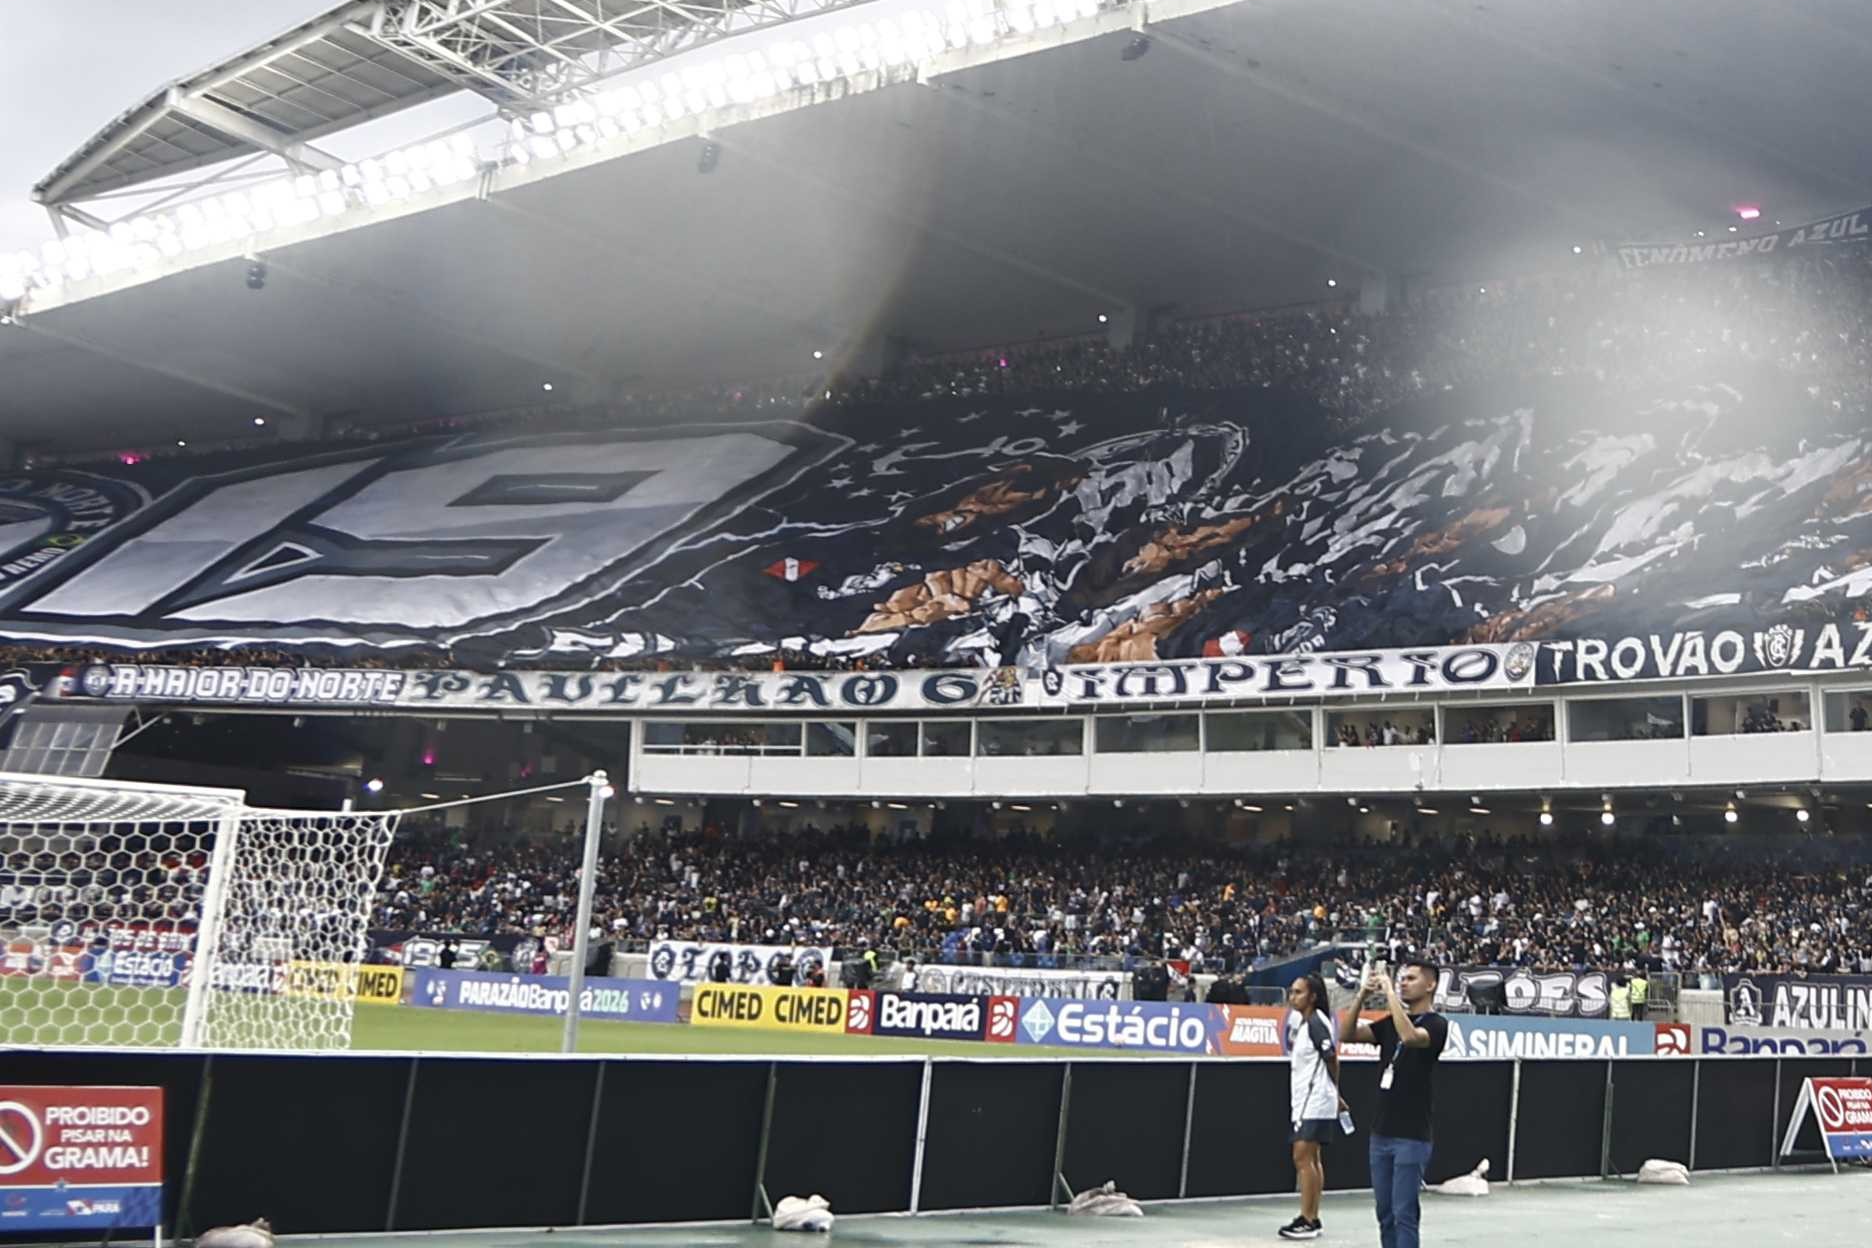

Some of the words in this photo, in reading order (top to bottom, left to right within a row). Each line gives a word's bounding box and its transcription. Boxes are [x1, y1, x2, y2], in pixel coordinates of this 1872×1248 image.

[1787, 213, 1869, 248] AZUL
[20, 432, 808, 630] 19
[1543, 627, 1746, 684] TROVÃO
[300, 669, 402, 704] NORTE
[403, 940, 479, 971] 195
[696, 989, 763, 1021] CIMED
[774, 994, 842, 1026] CIMED
[1433, 967, 1607, 1014] LÕES
[880, 995, 980, 1037] Banpará
[1057, 1000, 1204, 1048] Estácio
[45, 1106, 149, 1126] PROIBIDO
[61, 1129, 105, 1142] PISAR
[107, 1129, 132, 1142] NA
[44, 1146, 148, 1169] GRAMA!
